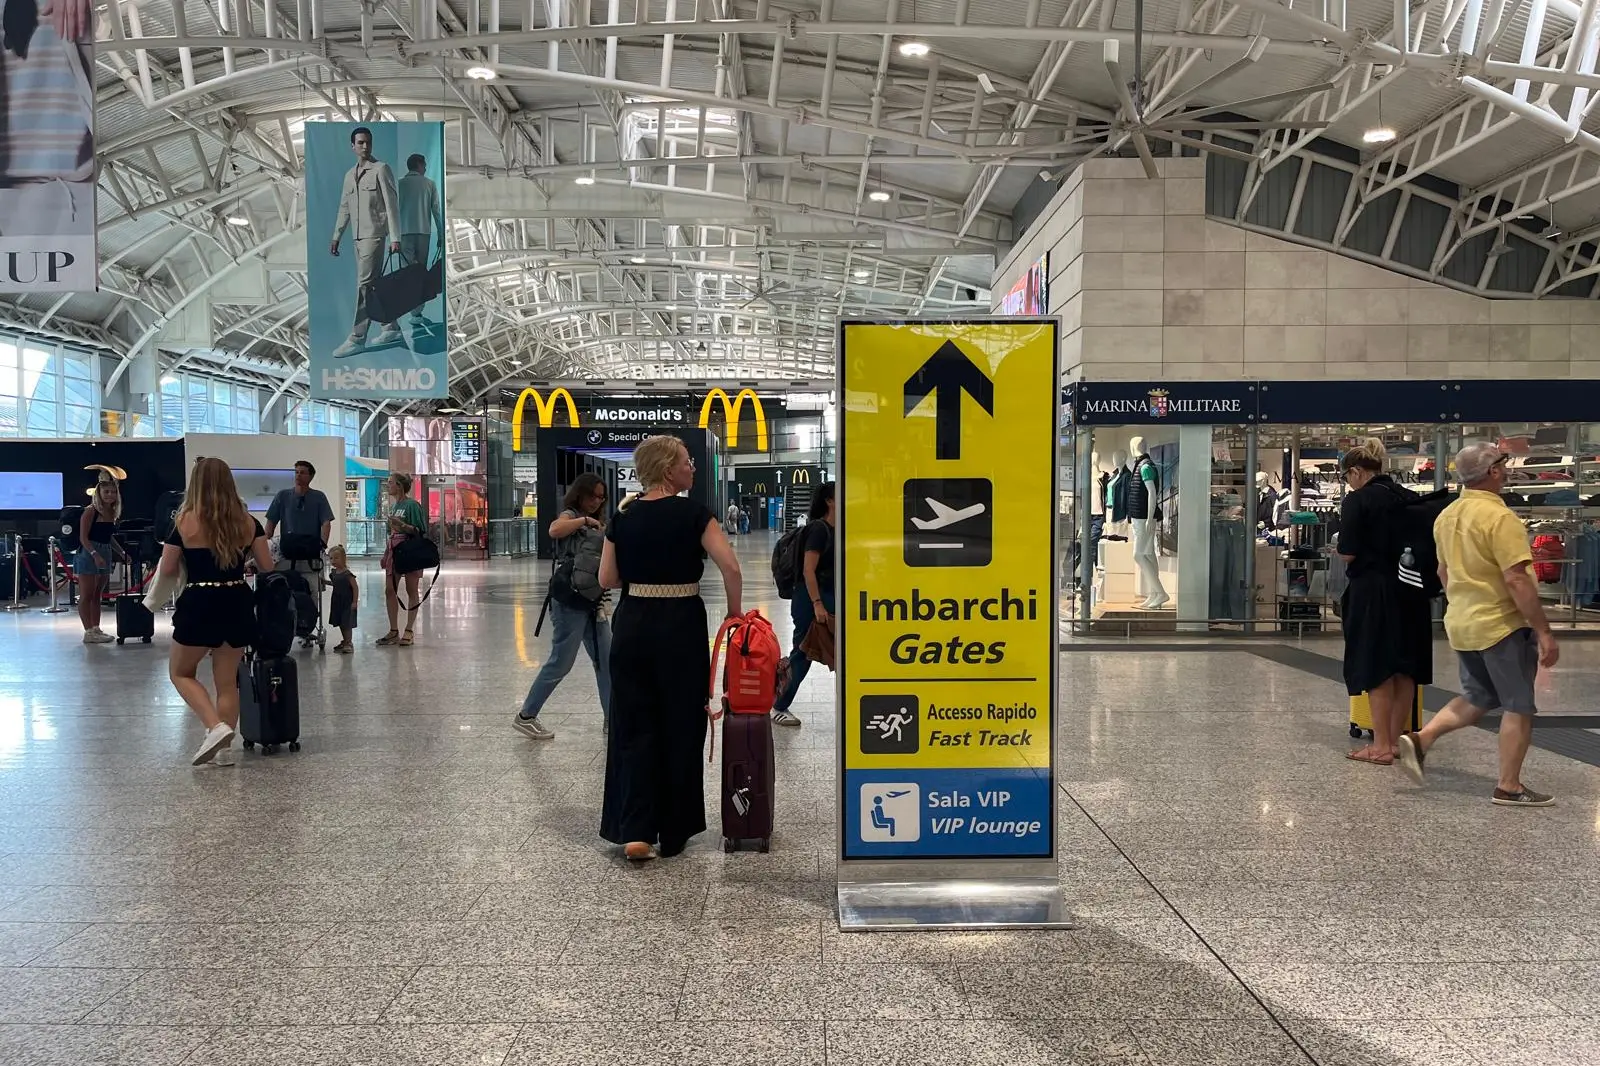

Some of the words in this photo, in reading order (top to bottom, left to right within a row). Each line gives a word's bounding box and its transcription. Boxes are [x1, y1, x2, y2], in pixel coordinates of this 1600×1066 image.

[0, 251, 75, 283] UP
[594, 408, 683, 421] McDonald's
[1084, 399, 1149, 413] MARINA
[1168, 399, 1242, 413] MILITARE
[608, 432, 640, 443] Special
[859, 587, 1037, 621] Imbarchi
[889, 633, 1006, 666] Gates
[927, 703, 983, 721] Accesso
[987, 702, 1037, 725] Rapido
[928, 730, 973, 747] Fast
[979, 730, 1034, 747] Track
[928, 790, 970, 809] Sala
[977, 790, 1012, 808] VIP
[931, 817, 965, 835] VIP
[969, 816, 1042, 839] lounge
